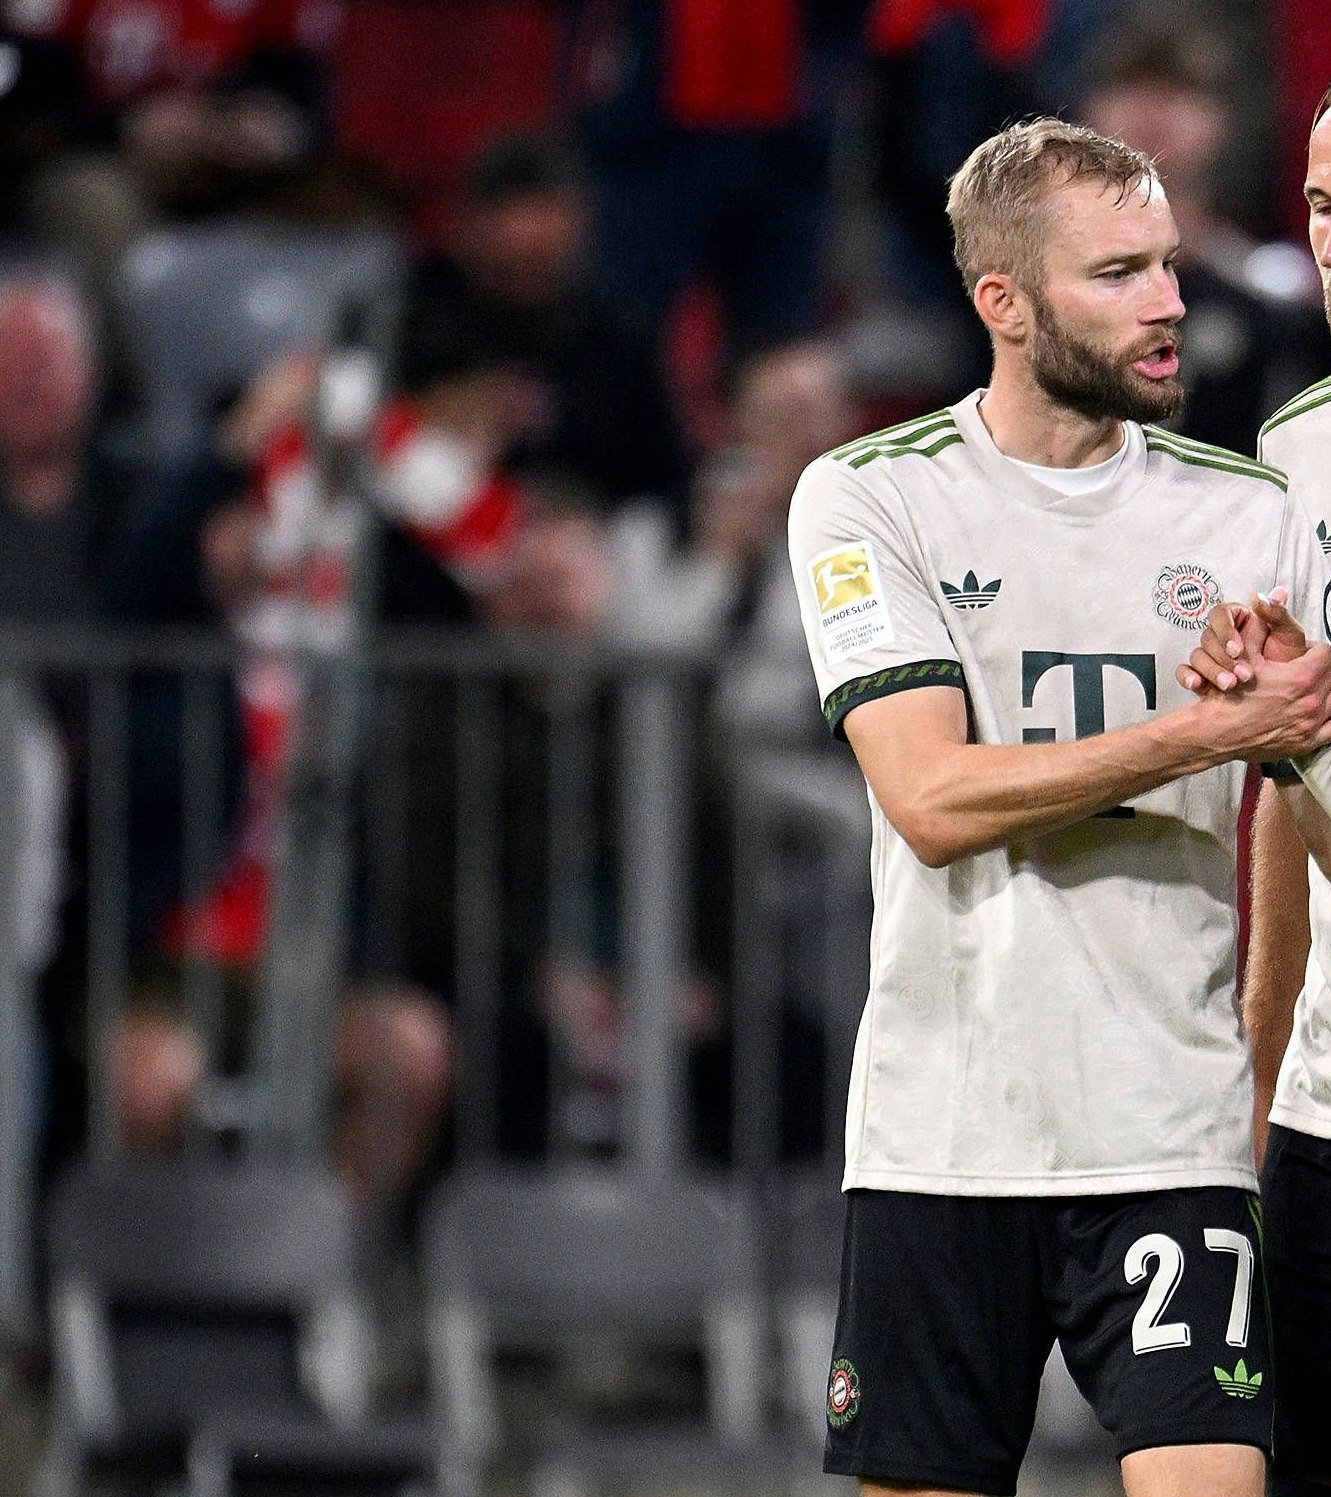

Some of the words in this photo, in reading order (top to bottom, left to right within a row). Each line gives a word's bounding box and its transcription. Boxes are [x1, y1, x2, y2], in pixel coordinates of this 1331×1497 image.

[1157, 564, 1219, 596] Bayern
[822, 599, 878, 628] BUNDESLIGA
[1156, 601, 1209, 630] Münche
[835, 622, 873, 641] DEUTSCHER
[841, 636, 874, 653] 2024/2025
[1124, 1228, 1254, 1355] 27
